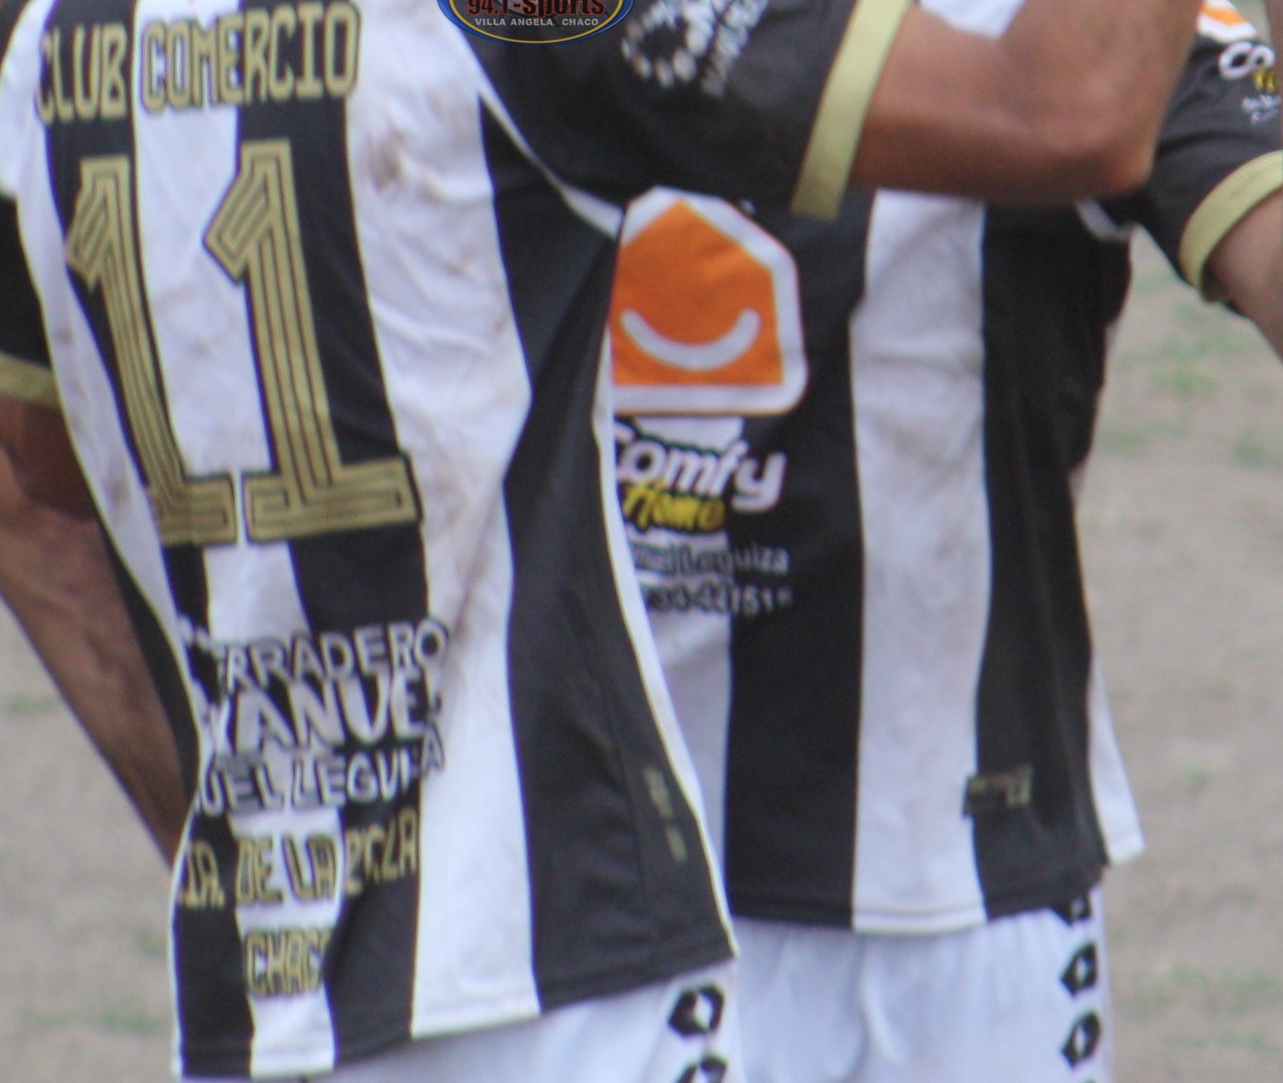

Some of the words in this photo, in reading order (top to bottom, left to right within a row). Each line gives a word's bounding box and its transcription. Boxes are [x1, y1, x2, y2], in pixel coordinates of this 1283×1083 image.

[140, 0, 363, 113] COMERCIO
[65, 136, 427, 548] 11
[198, 756, 287, 818] UEL
[235, 836, 283, 906] DE
[280, 832, 339, 902] LA
